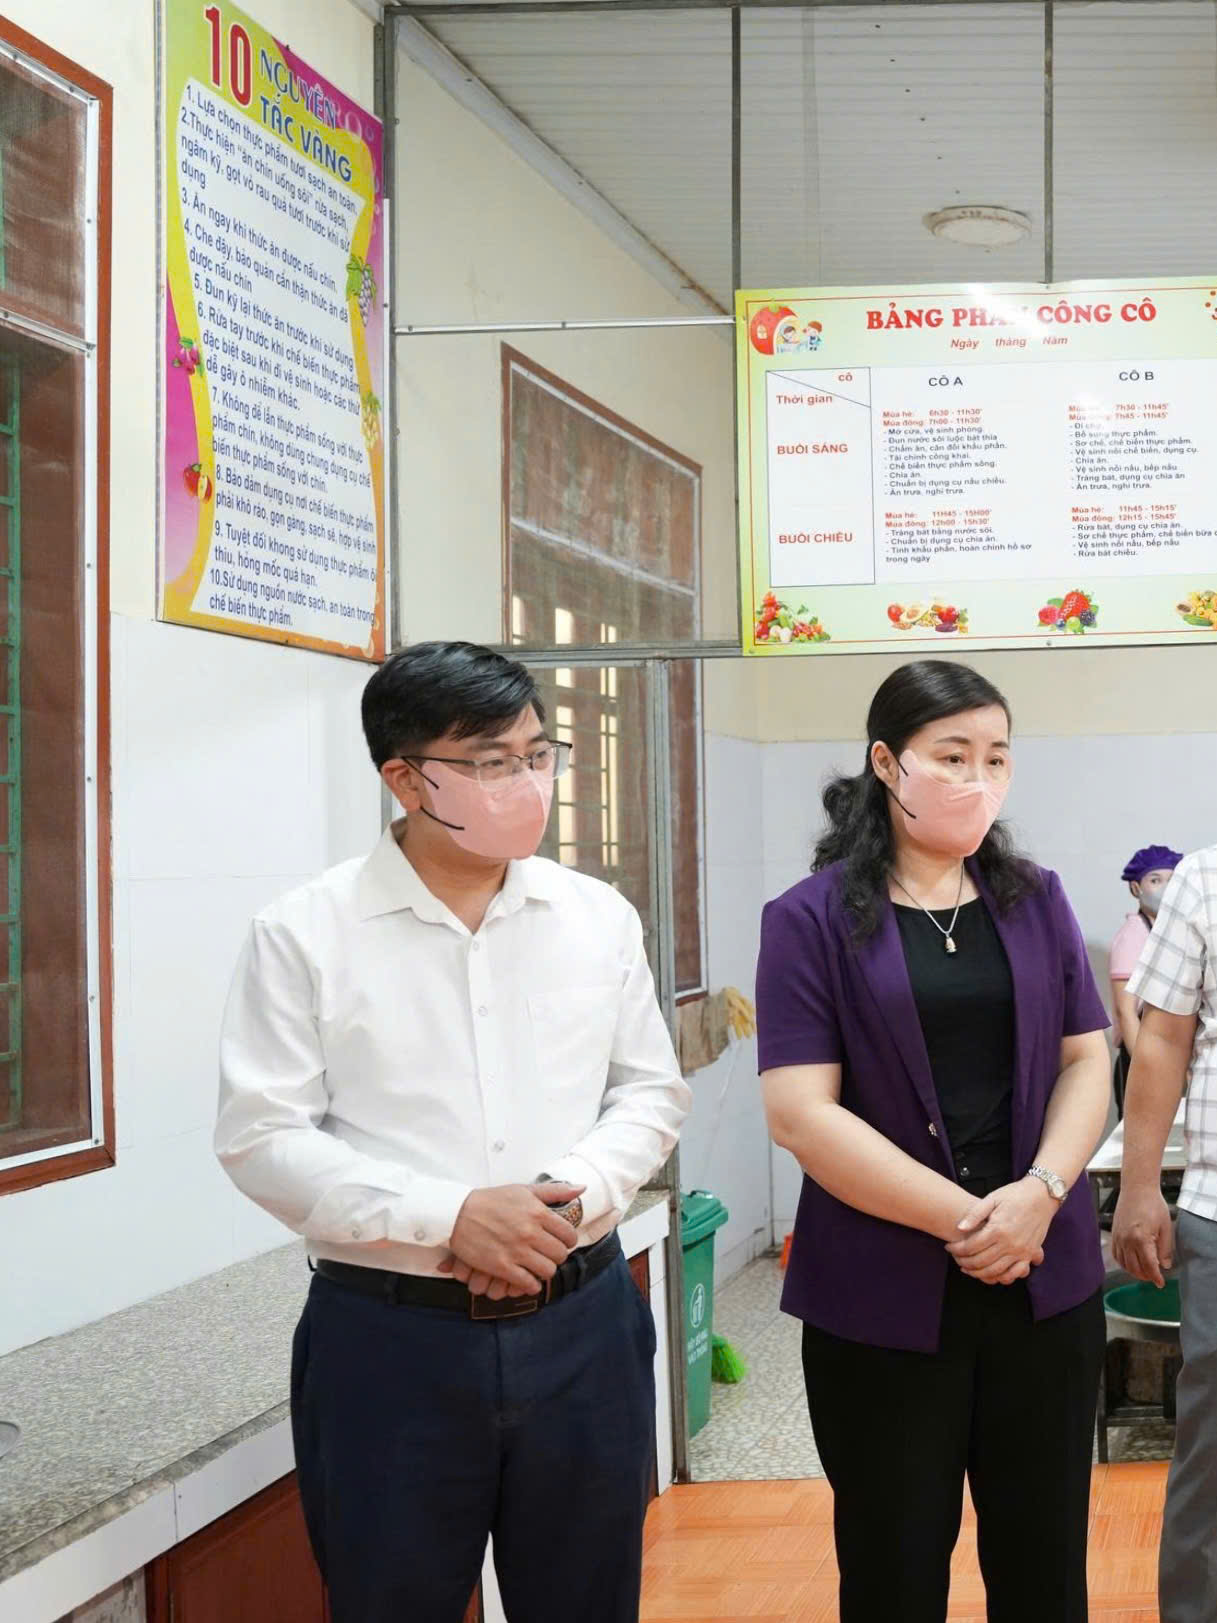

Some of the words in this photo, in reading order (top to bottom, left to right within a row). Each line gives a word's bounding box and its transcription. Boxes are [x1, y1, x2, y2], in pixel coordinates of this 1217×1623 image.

[205, 6, 251, 106] 10
[260, 49, 338, 130] NGUYÊN
[198, 91, 216, 117] Lựa
[218, 110, 241, 134] chọn
[243, 125, 263, 150] thực
[261, 93, 294, 143] TẮC
[301, 125, 352, 182] VÀNG
[216, 129, 236, 155] hiện
[182, 136, 208, 162] ngâm
[227, 165, 241, 184] gọt
[256, 182, 270, 201] rau
[182, 158, 206, 190] dụng
[182, 187, 191, 207] 3.
[209, 207, 231, 233] ngay
[233, 217, 248, 239] khi
[249, 228, 268, 252] thức
[281, 248, 302, 273] được
[184, 218, 193, 236] 4.
[195, 223, 214, 248] Che
[236, 246, 253, 269] bảo
[190, 247, 213, 273] được
[215, 260, 233, 283] nấu
[234, 273, 253, 293] chín
[194, 273, 203, 291] 5.
[206, 278, 225, 302] Đun
[240, 296, 251, 320] lại
[252, 303, 273, 327] thức
[286, 322, 309, 345] trước
[867, 302, 944, 329] BẢNG
[1036, 300, 1112, 323] CÔNG
[1121, 297, 1157, 322] CÔ
[198, 301, 206, 319] 6.
[208, 306, 228, 329] Rửa
[230, 318, 245, 341] tay
[246, 327, 271, 350] trước
[271, 338, 285, 357] khi
[950, 338, 979, 350] Ngày
[995, 336, 1027, 349] tháng
[203, 329, 221, 352] đặc
[222, 338, 240, 361] biệt
[241, 350, 257, 368] sau
[258, 355, 273, 374] khi
[283, 369, 294, 388] vệ
[295, 376, 313, 394] sinh
[1118, 369, 1140, 381] CÔ
[1144, 371, 1154, 380] B
[220, 363, 238, 386] gây
[249, 376, 277, 400] nhiễm
[928, 375, 949, 387] CÔ
[952, 376, 963, 386] A
[222, 392, 251, 420] Không
[776, 394, 803, 405] Thời
[807, 394, 833, 406] gian
[212, 411, 237, 434] phẩm
[259, 431, 285, 458] không
[812, 442, 849, 454] SÁNG
[212, 434, 231, 457] biến
[232, 444, 252, 466] thực
[252, 452, 276, 476] phẩm
[276, 460, 297, 485] sống
[215, 489, 234, 511] phải
[225, 466, 243, 488] Bảo
[244, 473, 263, 493] đảm
[263, 482, 284, 507] dụng
[225, 522, 250, 548] Tuyệt
[262, 558, 282, 578] mốc
[885, 555, 908, 564] trong
[910, 554, 931, 564] ngày
[236, 574, 259, 599] dụng
[208, 594, 227, 612] chế
[227, 595, 247, 617] biến
[248, 601, 268, 624] thực
